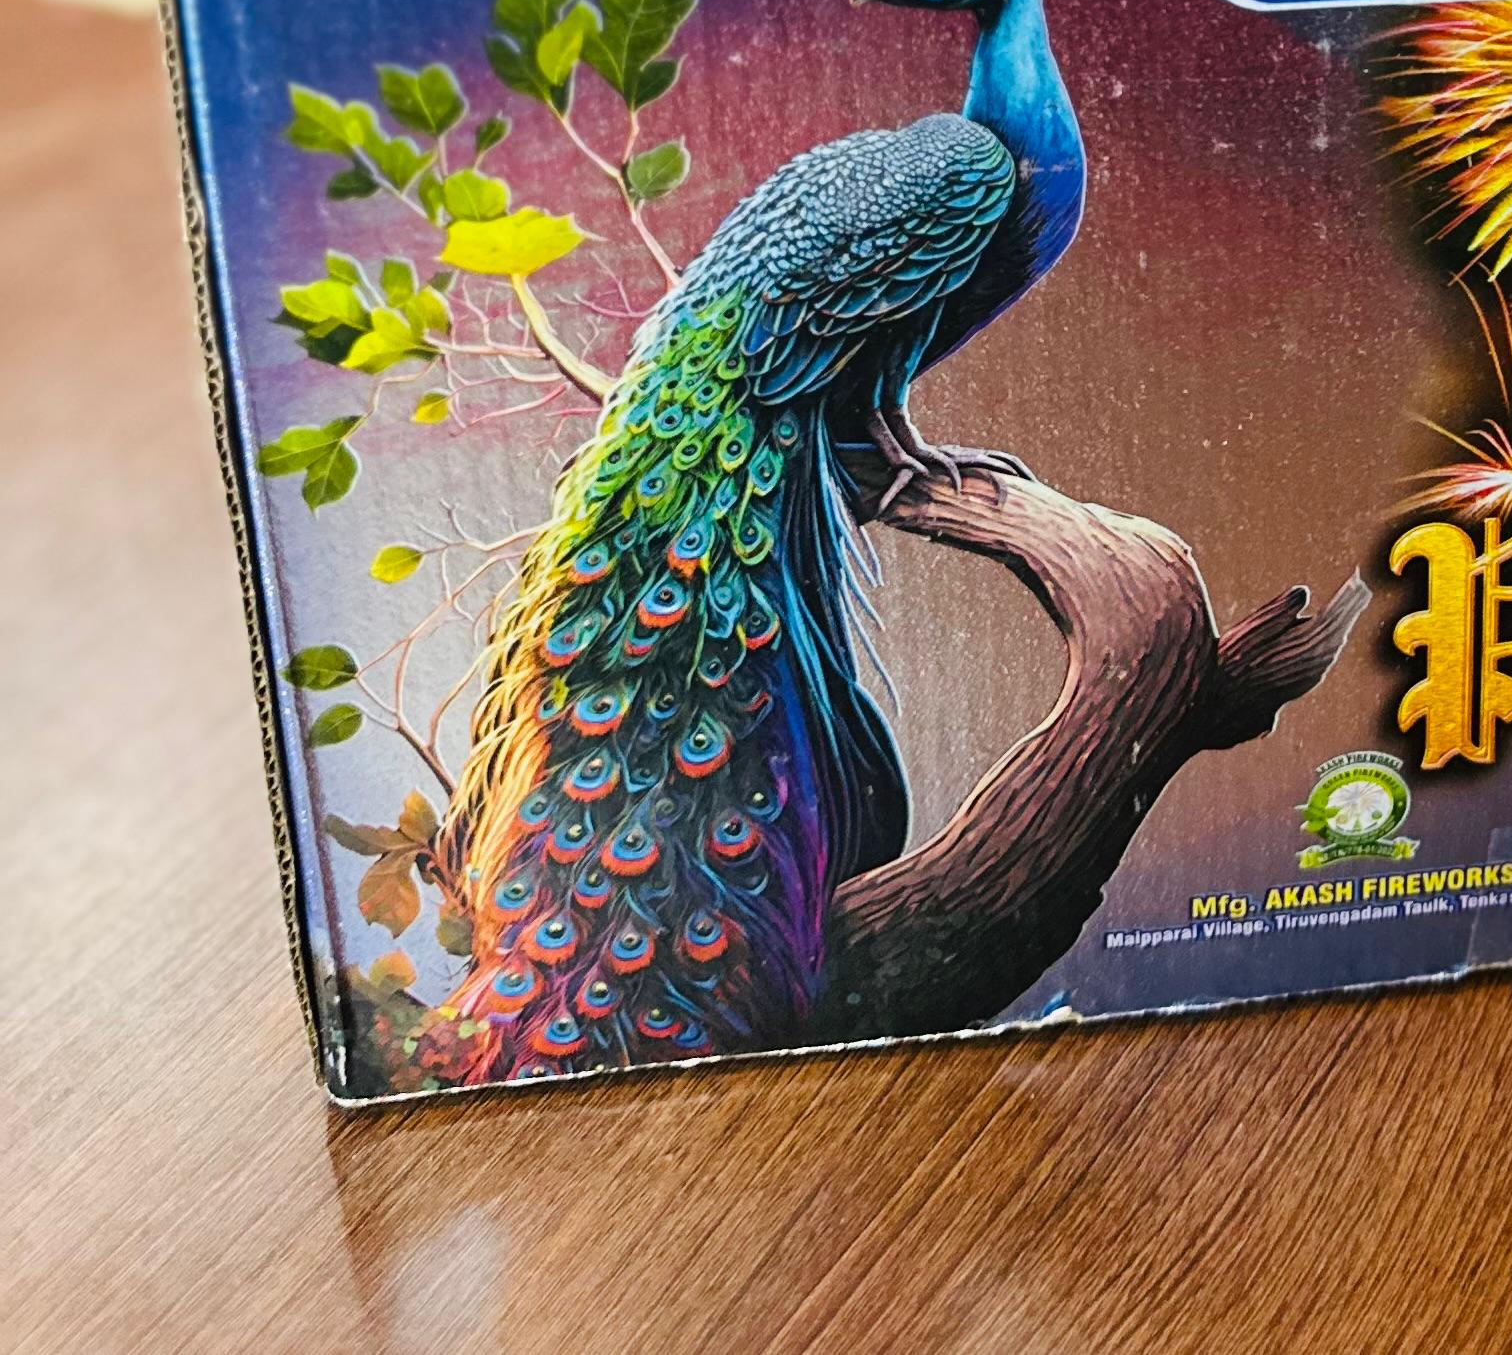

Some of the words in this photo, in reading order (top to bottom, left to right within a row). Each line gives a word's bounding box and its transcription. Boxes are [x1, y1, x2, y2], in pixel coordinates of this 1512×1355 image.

[1192, 894, 1255, 919] Mfg.
[1265, 876, 1353, 910] AKASH
[1203, 918, 1269, 939] Village,
[1275, 903, 1397, 931] Tiruvengadam
